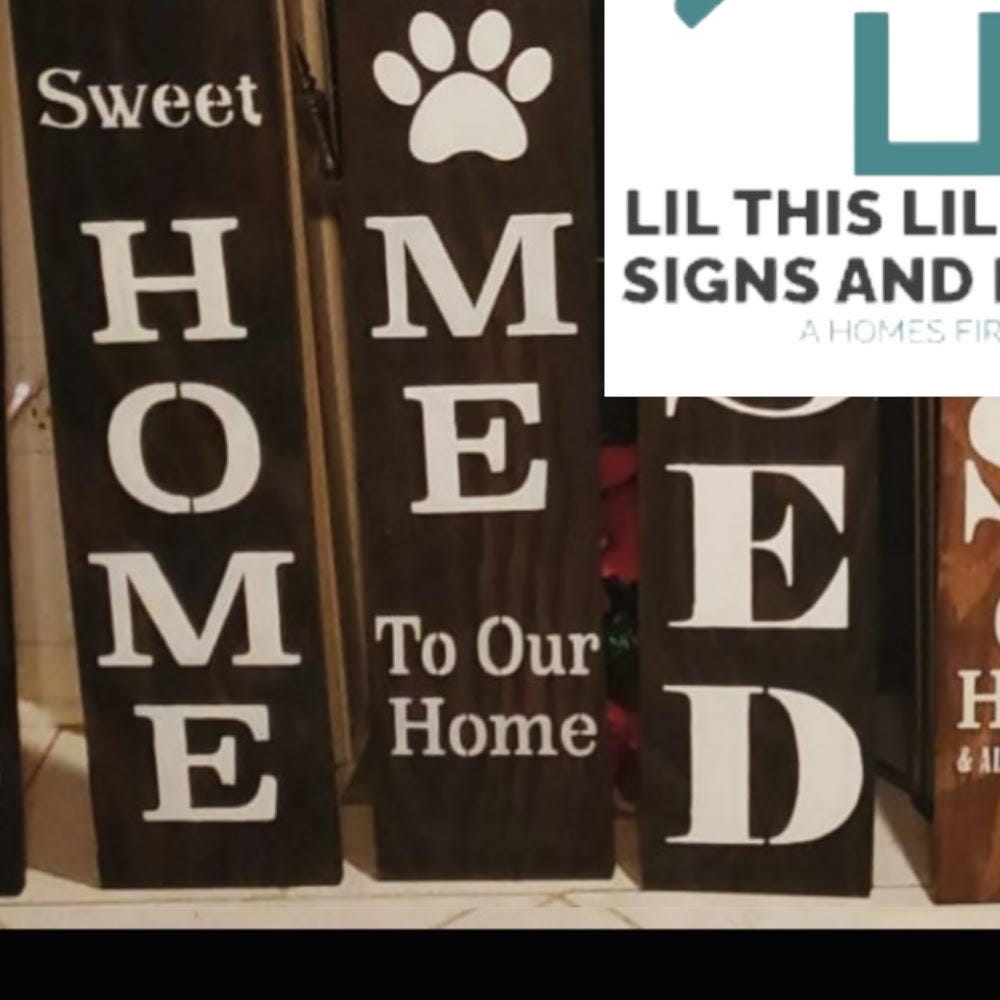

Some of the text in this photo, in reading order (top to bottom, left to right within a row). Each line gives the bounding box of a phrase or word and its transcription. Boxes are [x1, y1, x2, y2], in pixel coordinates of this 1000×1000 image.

[37, 67, 263, 129] Sweet
[88, 217, 301, 822] HOME
[374, 615, 600, 676] To Our
[388, 696, 598, 757] Home
[956, 746, 973, 774] &
